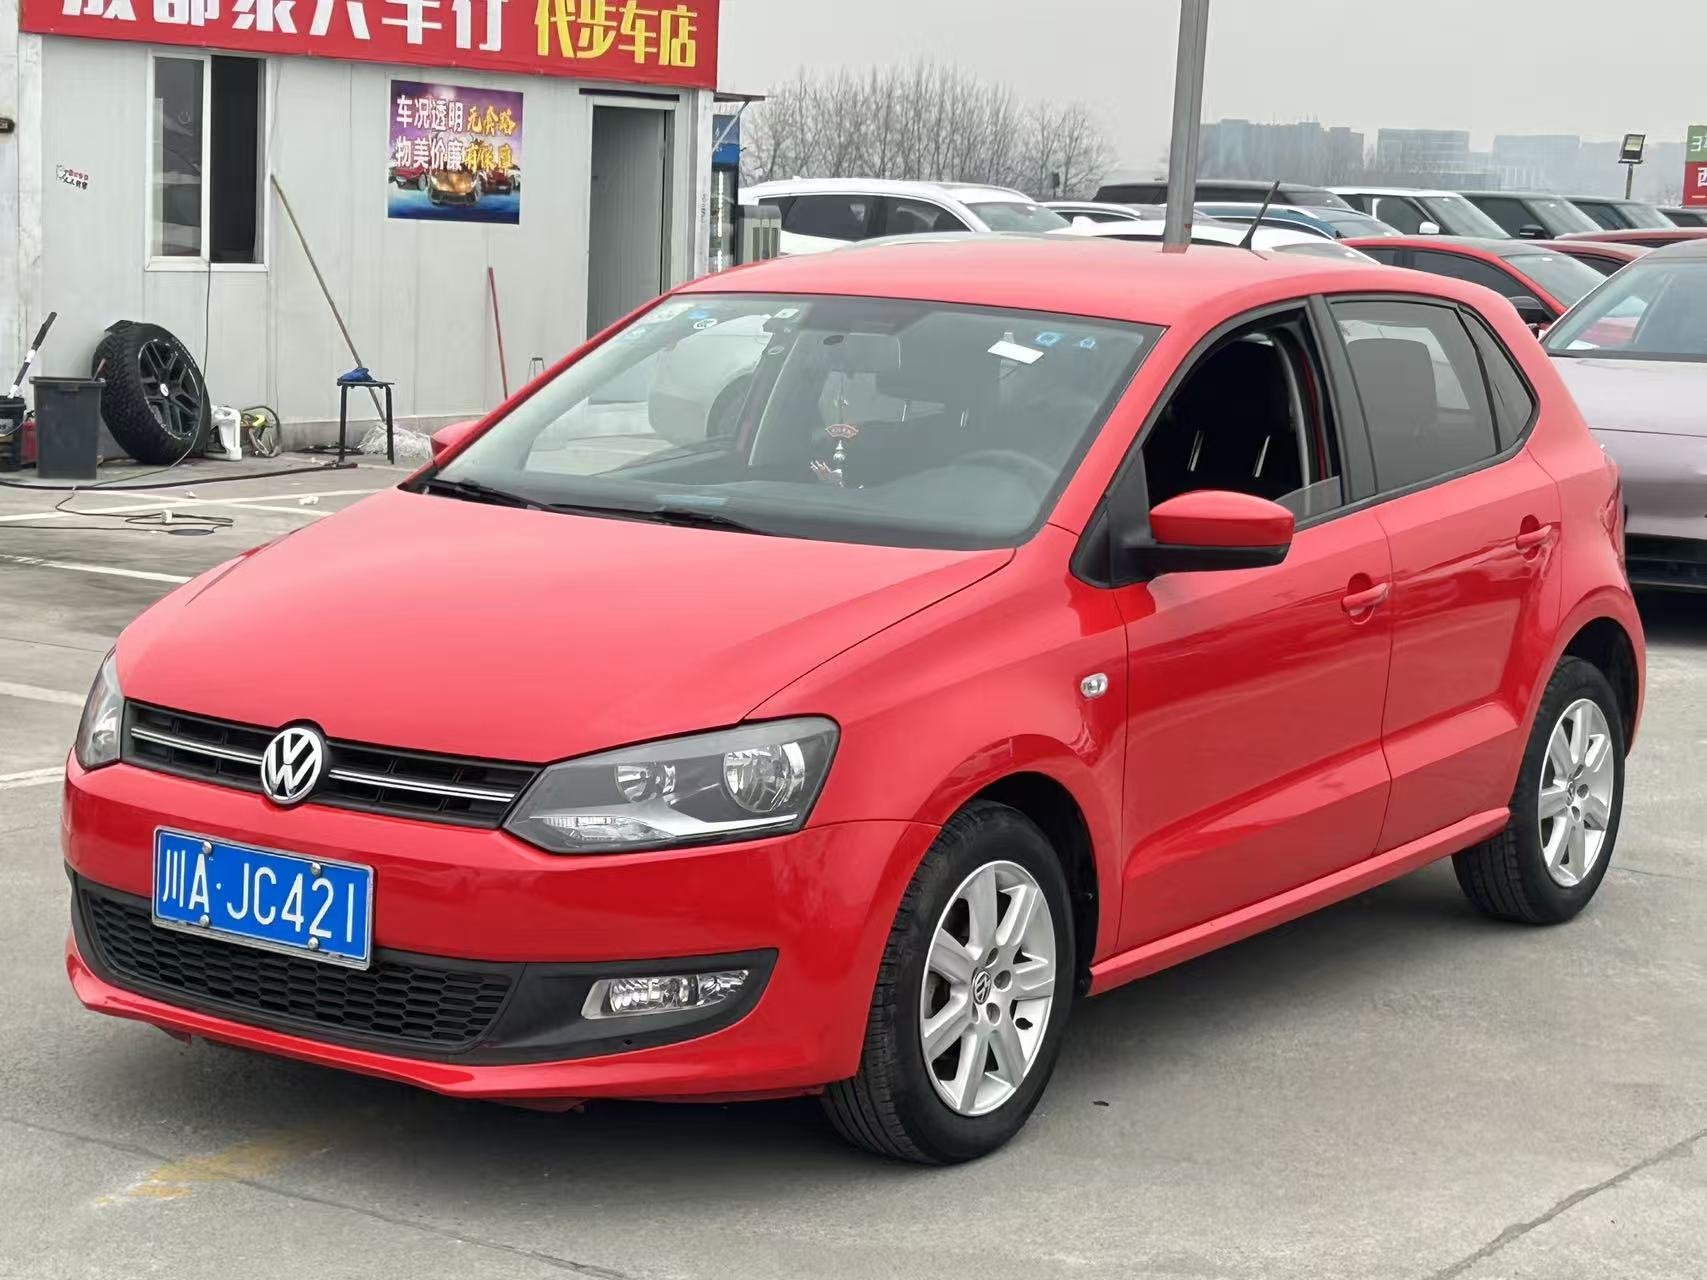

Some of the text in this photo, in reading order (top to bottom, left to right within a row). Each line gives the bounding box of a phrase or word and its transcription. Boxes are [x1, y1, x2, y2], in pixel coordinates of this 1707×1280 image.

[534, 0, 697, 67] 代步车店
[396, 94, 463, 132] 车况透明
[395, 135, 463, 171] 物美价廉
